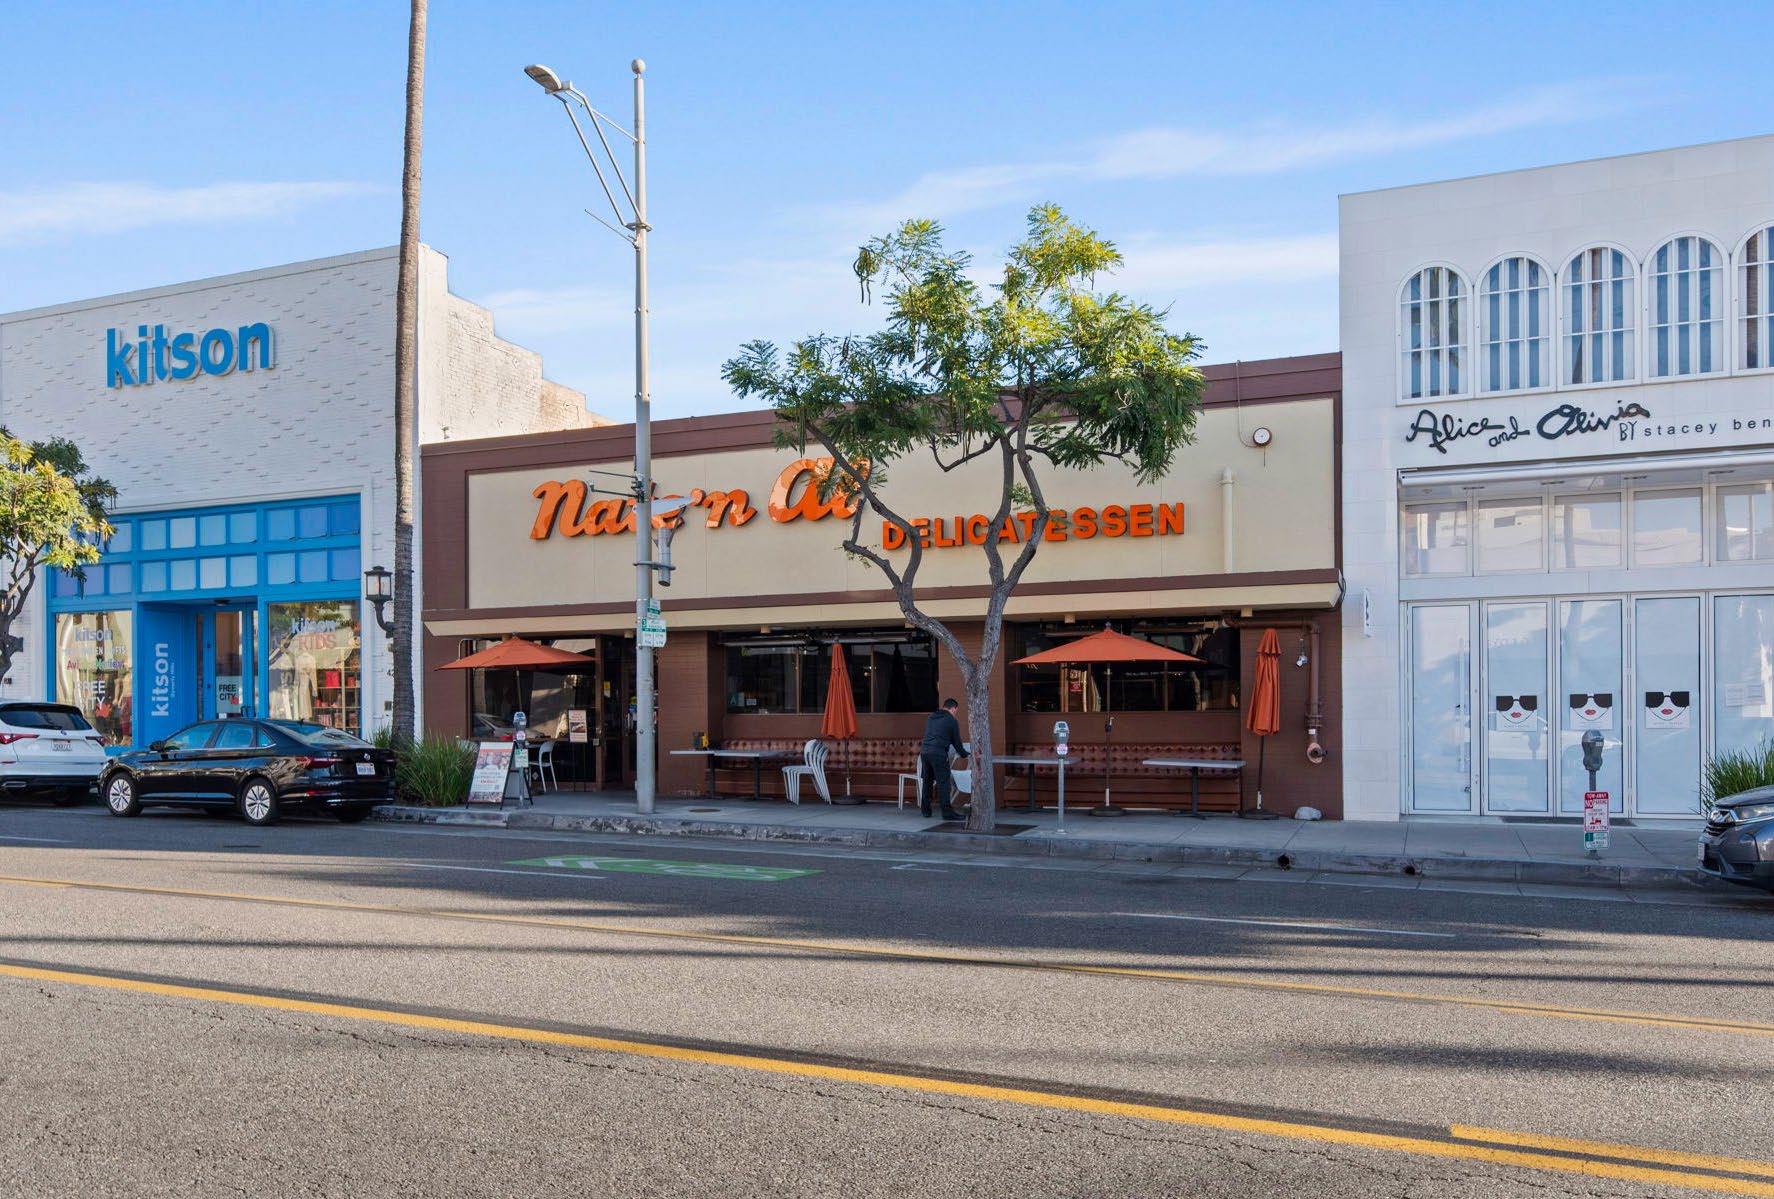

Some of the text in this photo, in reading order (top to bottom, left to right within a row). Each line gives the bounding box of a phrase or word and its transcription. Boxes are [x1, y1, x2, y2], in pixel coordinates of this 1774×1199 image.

[106, 321, 276, 390] kitson
[1405, 409, 1506, 455] Alice
[1488, 416, 1531, 448] and
[1536, 400, 1651, 440] Olivia
[1619, 420, 1638, 442] BY
[1643, 422, 1718, 438] stacey
[529, 479, 686, 541] Nae
[882, 502, 1186, 551] DELICATESSEN
[151, 643, 169, 717] kitson
[218, 683, 237, 693] FREE
[219, 692, 237, 701] CITY
